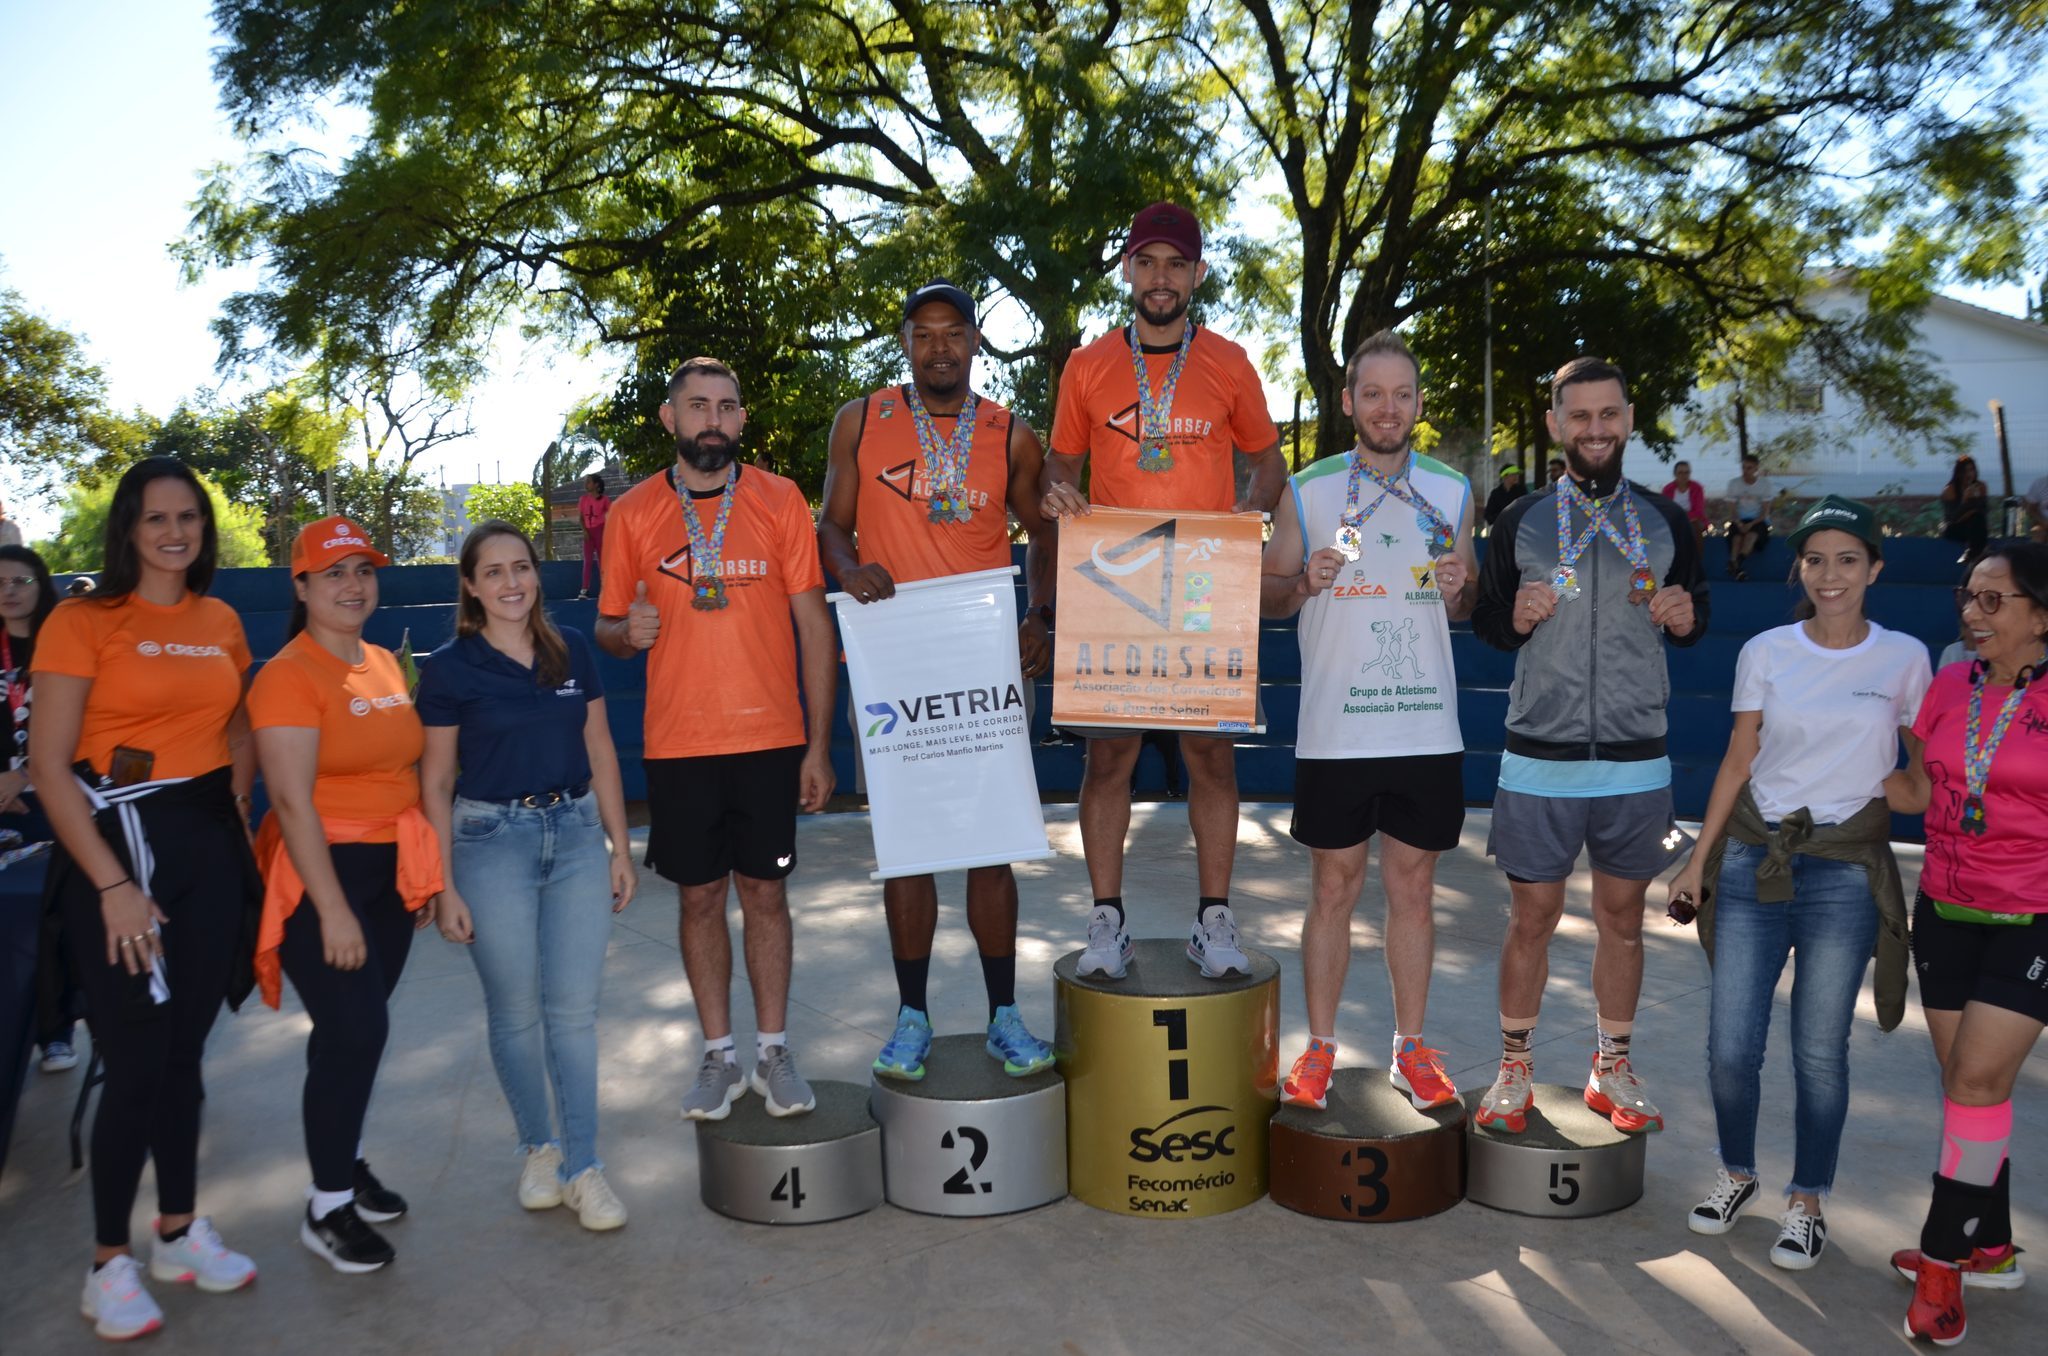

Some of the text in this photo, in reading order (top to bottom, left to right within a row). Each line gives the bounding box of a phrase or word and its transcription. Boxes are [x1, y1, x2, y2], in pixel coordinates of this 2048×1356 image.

[1334, 584, 1388, 597] ZACA
[164, 643, 229, 657] CRESOL
[1076, 643, 1243, 680] ACORSEB
[1073, 680, 1242, 697] Associação dos Corredores
[1350, 685, 1437, 699] Grupo de Atletismo
[898, 684, 1023, 723] VETRIA
[1103, 702, 1118, 713] de
[1150, 703, 1166, 714] de
[1170, 705, 1210, 716] Seberi
[1343, 701, 1444, 714] Associação Portelense
[906, 714, 1023, 737] ASSESSORIA DE CORRIDA
[869, 746, 890, 755] MAIS
[893, 741, 924, 752] LONGE,
[926, 738, 947, 747] MAIS
[949, 735, 973, 744] LEVE,
[975, 731, 997, 740] MAIS
[903, 743, 1004, 763] Prof Carlos Manfio Martins
[2027, 956, 2046, 980] GRIT
[1153, 1008, 1189, 1100] 1
[1128, 1116, 1235, 1163] Sesc
[940, 1126, 992, 1194] 2
[770, 1166, 806, 1209] 4
[1128, 1171, 1235, 1192] Fecomércio
[1340, 1146, 1390, 1217] 3
[1548, 1163, 1580, 1206] 5
[1129, 1196, 1188, 1213] Senac
